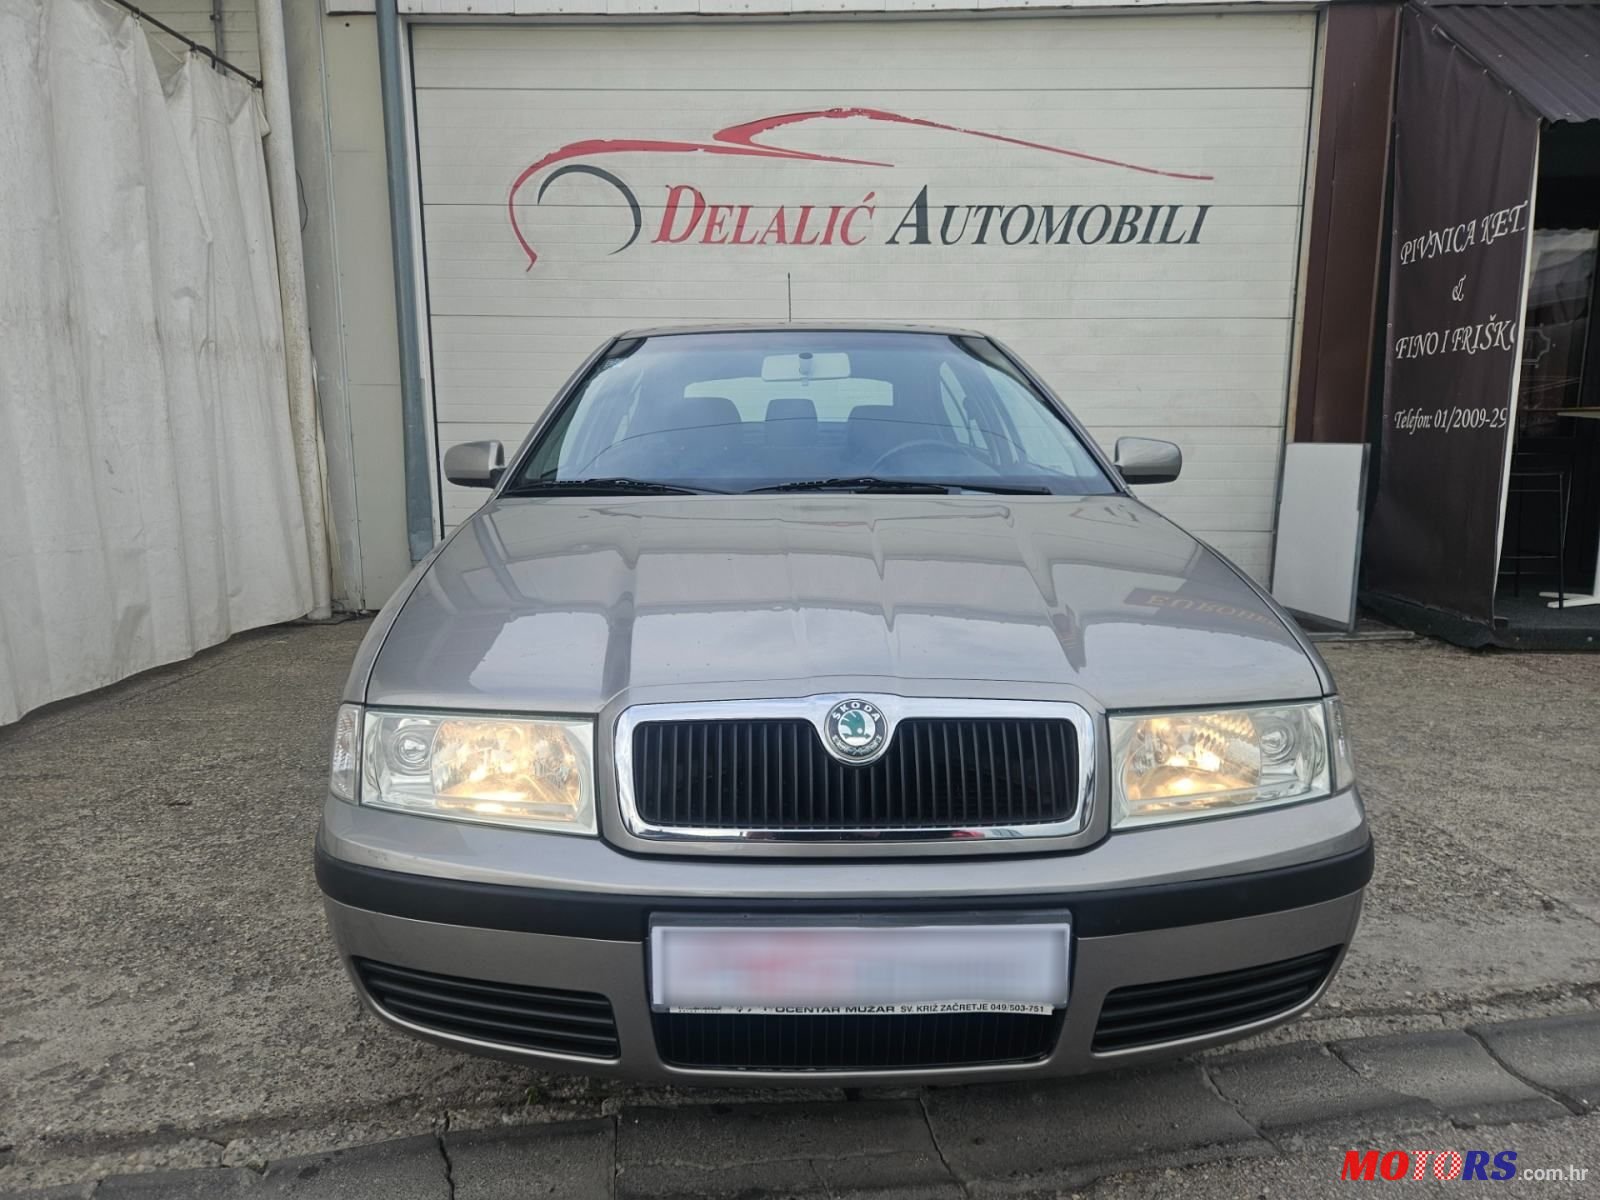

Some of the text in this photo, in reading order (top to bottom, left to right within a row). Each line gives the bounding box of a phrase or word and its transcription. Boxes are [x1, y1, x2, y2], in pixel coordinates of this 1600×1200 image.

[650, 184, 1213, 246] DELALIĆ AUTOMOBILI
[1400, 199, 1529, 265] PIVNICA KET
[1451, 274, 1467, 302] &
[1395, 331, 1439, 359] FINO
[1440, 329, 1451, 354] I
[1394, 407, 1433, 435] Telefon:
